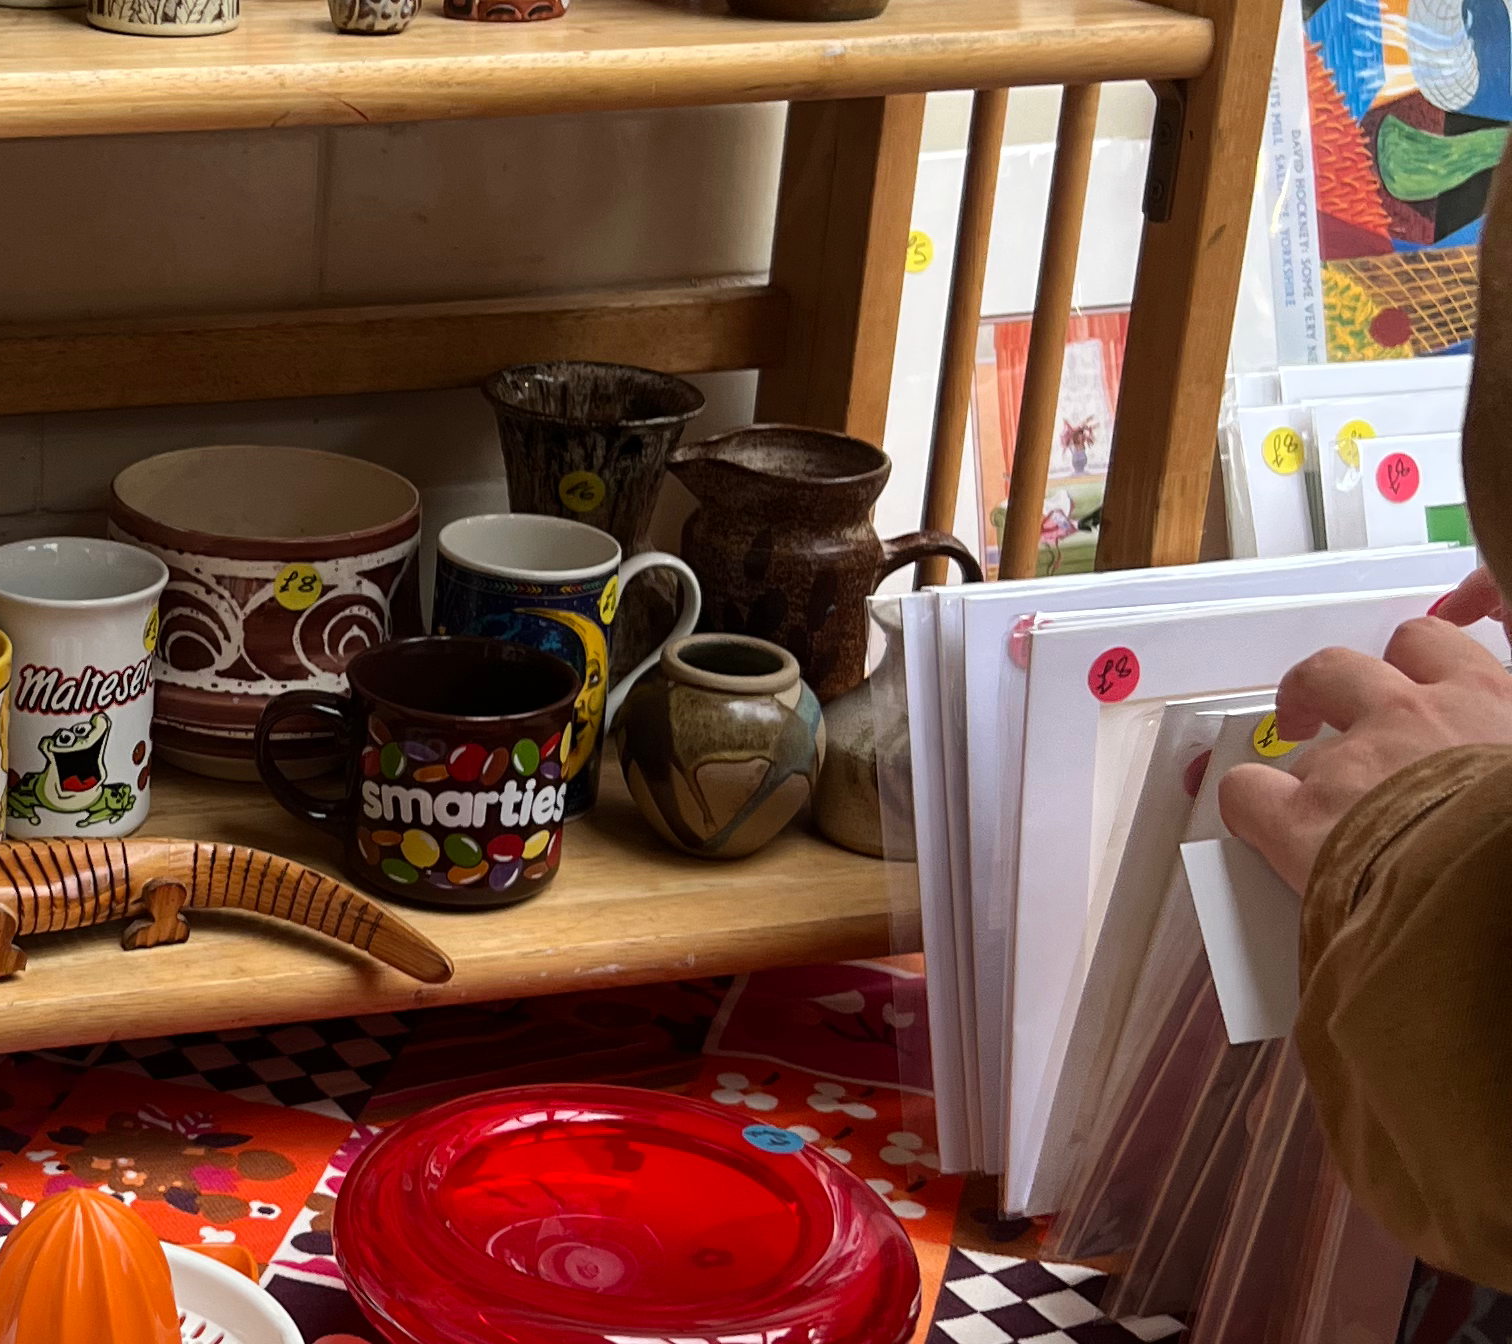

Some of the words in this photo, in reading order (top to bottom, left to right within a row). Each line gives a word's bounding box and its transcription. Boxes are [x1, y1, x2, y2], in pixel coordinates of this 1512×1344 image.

[1291, 129, 1304, 174] DAVID
[1300, 258, 1315, 300] SOME
[1304, 302, 1317, 341] VERY
[1272, 433, 1299, 468] £8
[1388, 457, 1410, 495] £8
[279, 570, 317, 593] £8
[15, 655, 153, 715] Malteser
[1096, 655, 1132, 695] £8
[362, 778, 567, 828] smarties
